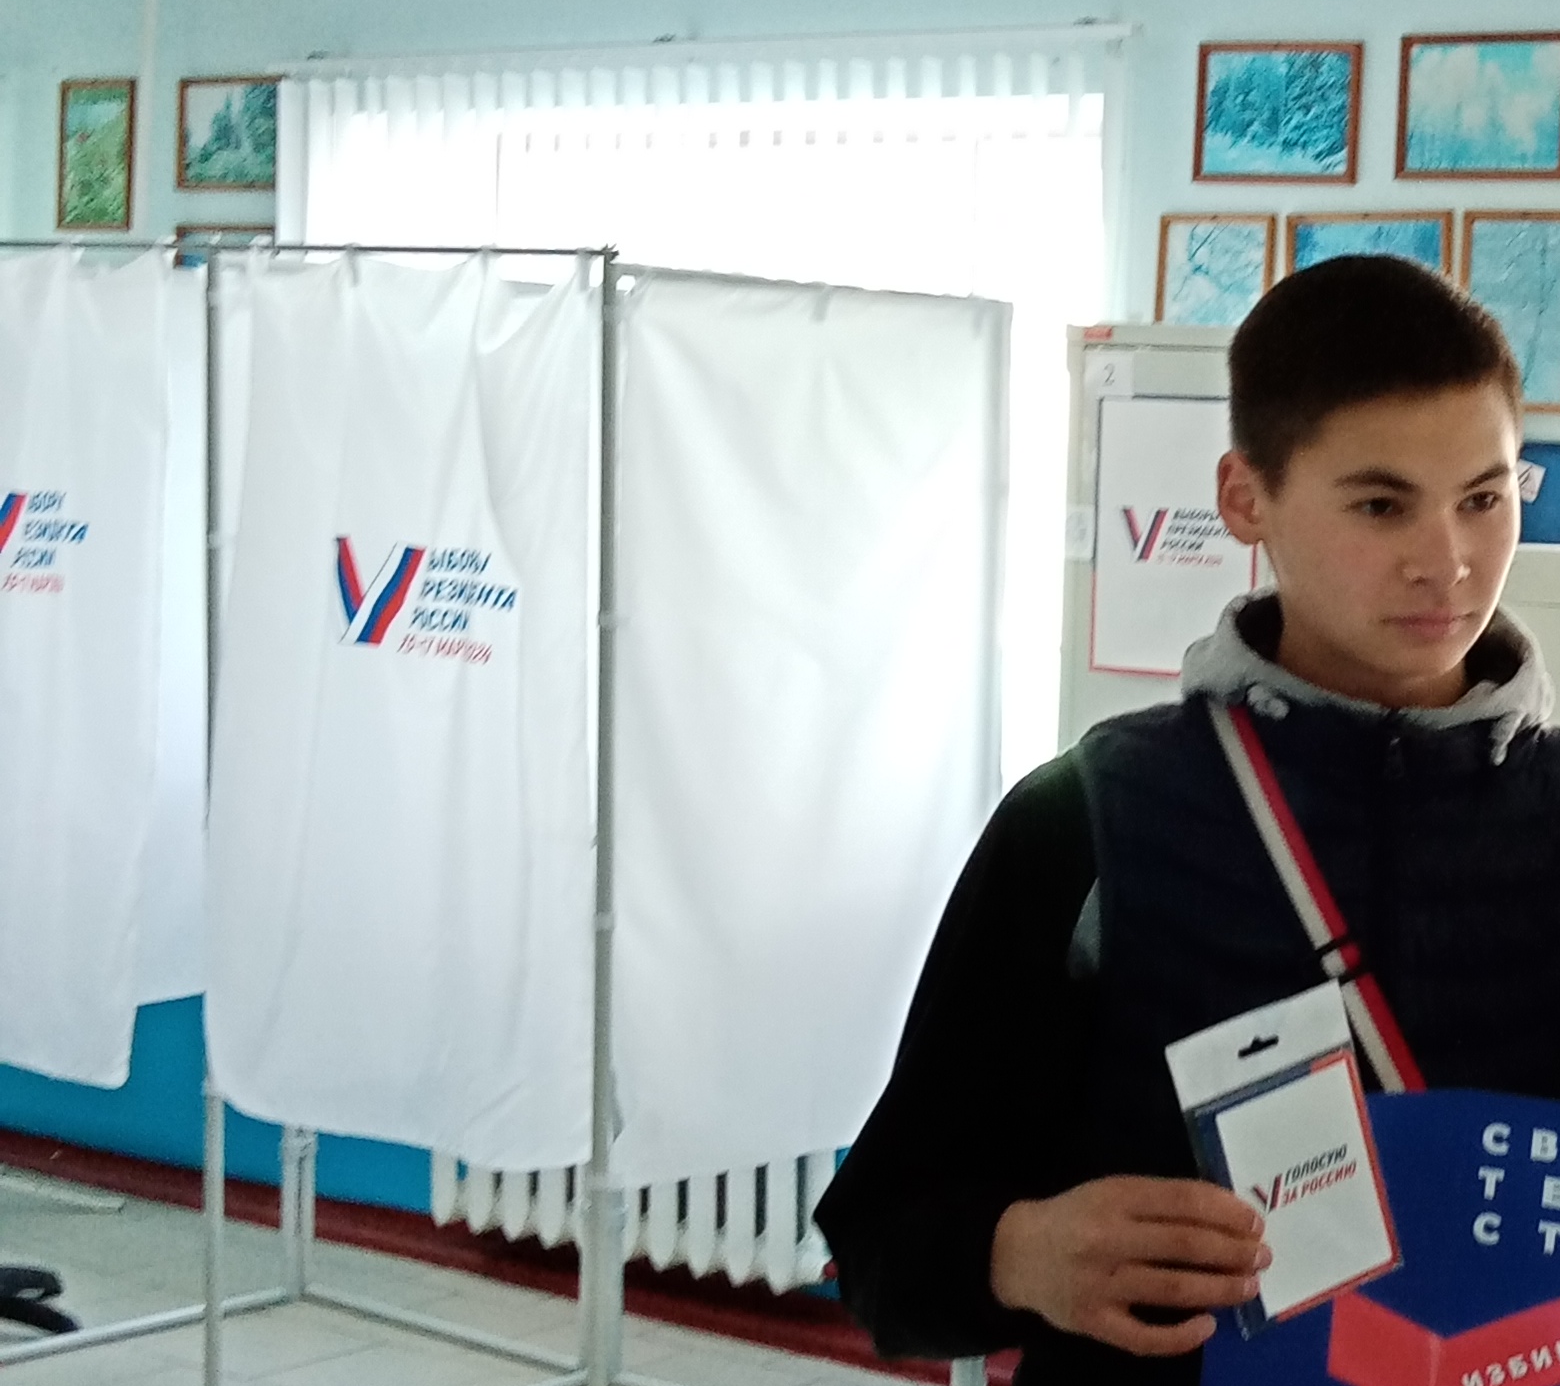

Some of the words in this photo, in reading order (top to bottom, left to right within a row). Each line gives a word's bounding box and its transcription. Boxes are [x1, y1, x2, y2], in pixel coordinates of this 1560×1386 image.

[1281, 1186, 1298, 1207] ЗА
[1300, 1158, 1358, 1199] РОССИЮ
[1284, 1142, 1348, 1187] ГОЛОСУЮ
